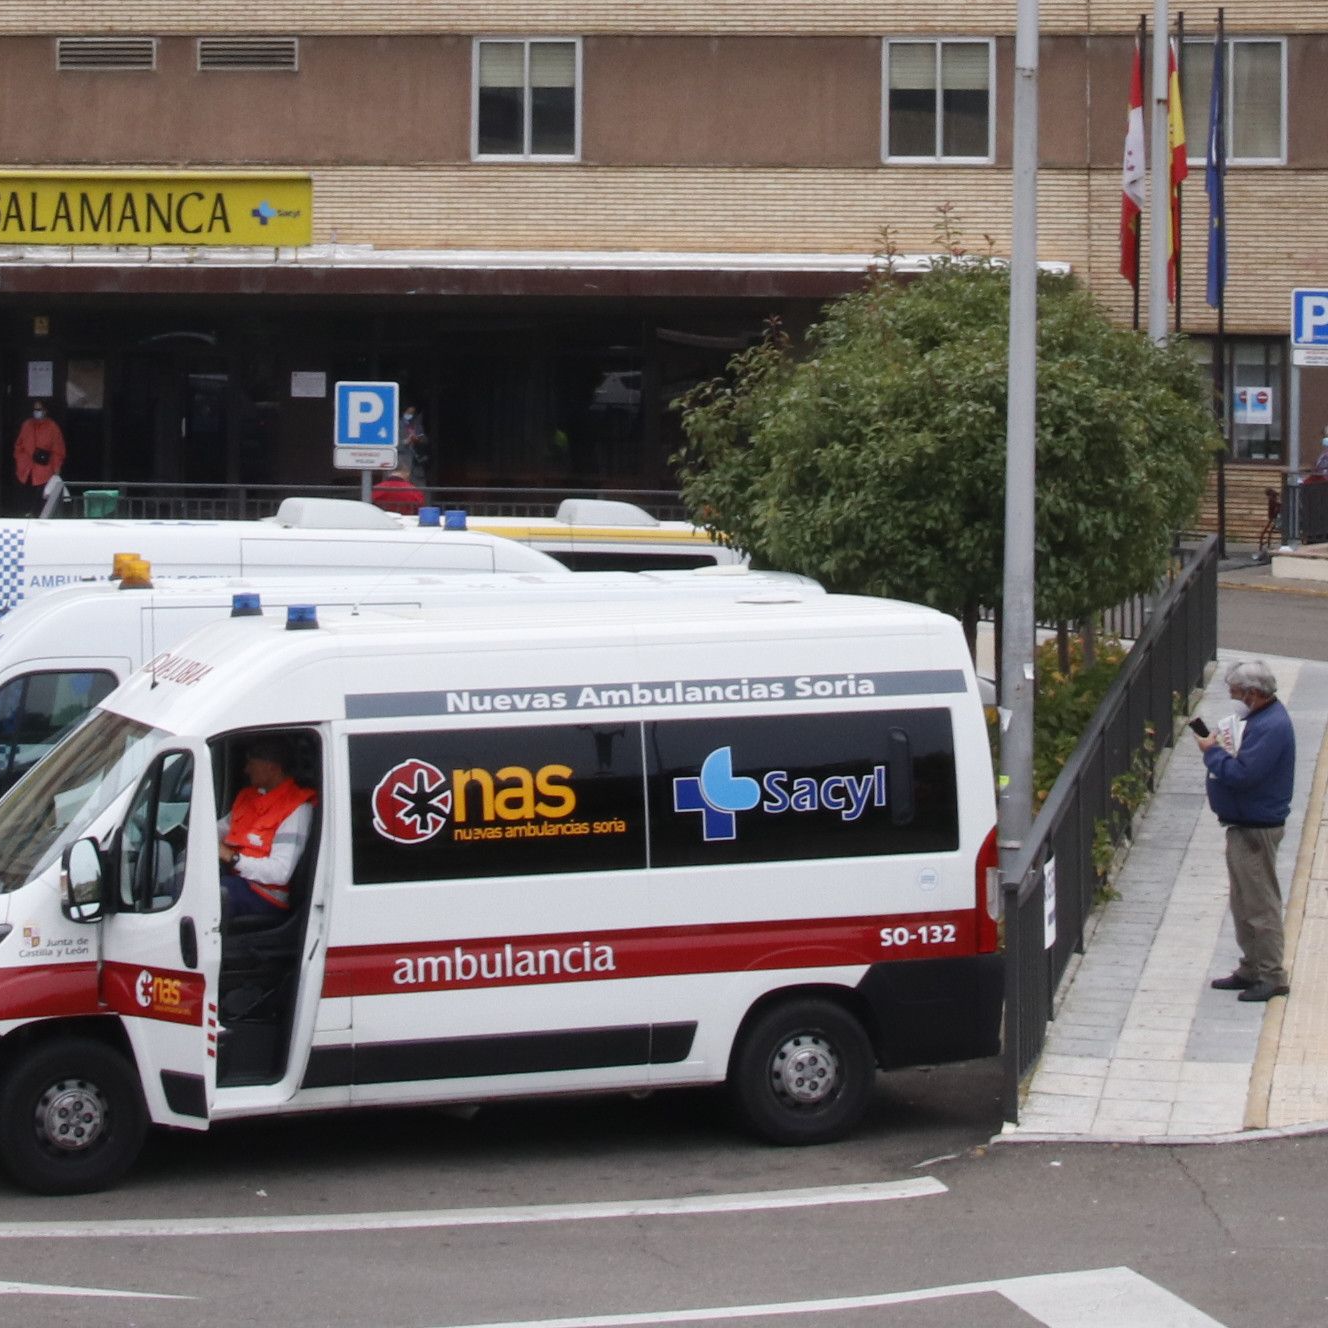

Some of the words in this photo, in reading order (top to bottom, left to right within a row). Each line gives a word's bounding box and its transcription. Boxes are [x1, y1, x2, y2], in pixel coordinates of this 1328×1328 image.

[348, 392, 384, 438] P
[446, 691, 567, 713] Nuevas
[576, 680, 785, 708] Ambulancias
[795, 675, 875, 698] Soria
[452, 764, 576, 822] nas
[763, 765, 886, 820] Sacyl
[453, 826, 503, 841] nuevas
[505, 819, 589, 838] ambulancias
[593, 817, 626, 834] soria
[47, 938, 73, 947] Junta
[879, 924, 956, 947] SO-132
[18, 949, 52, 958] Castilla
[65, 947, 89, 955] León
[393, 941, 616, 984] ambulancia
[153, 977, 182, 1005] nas
